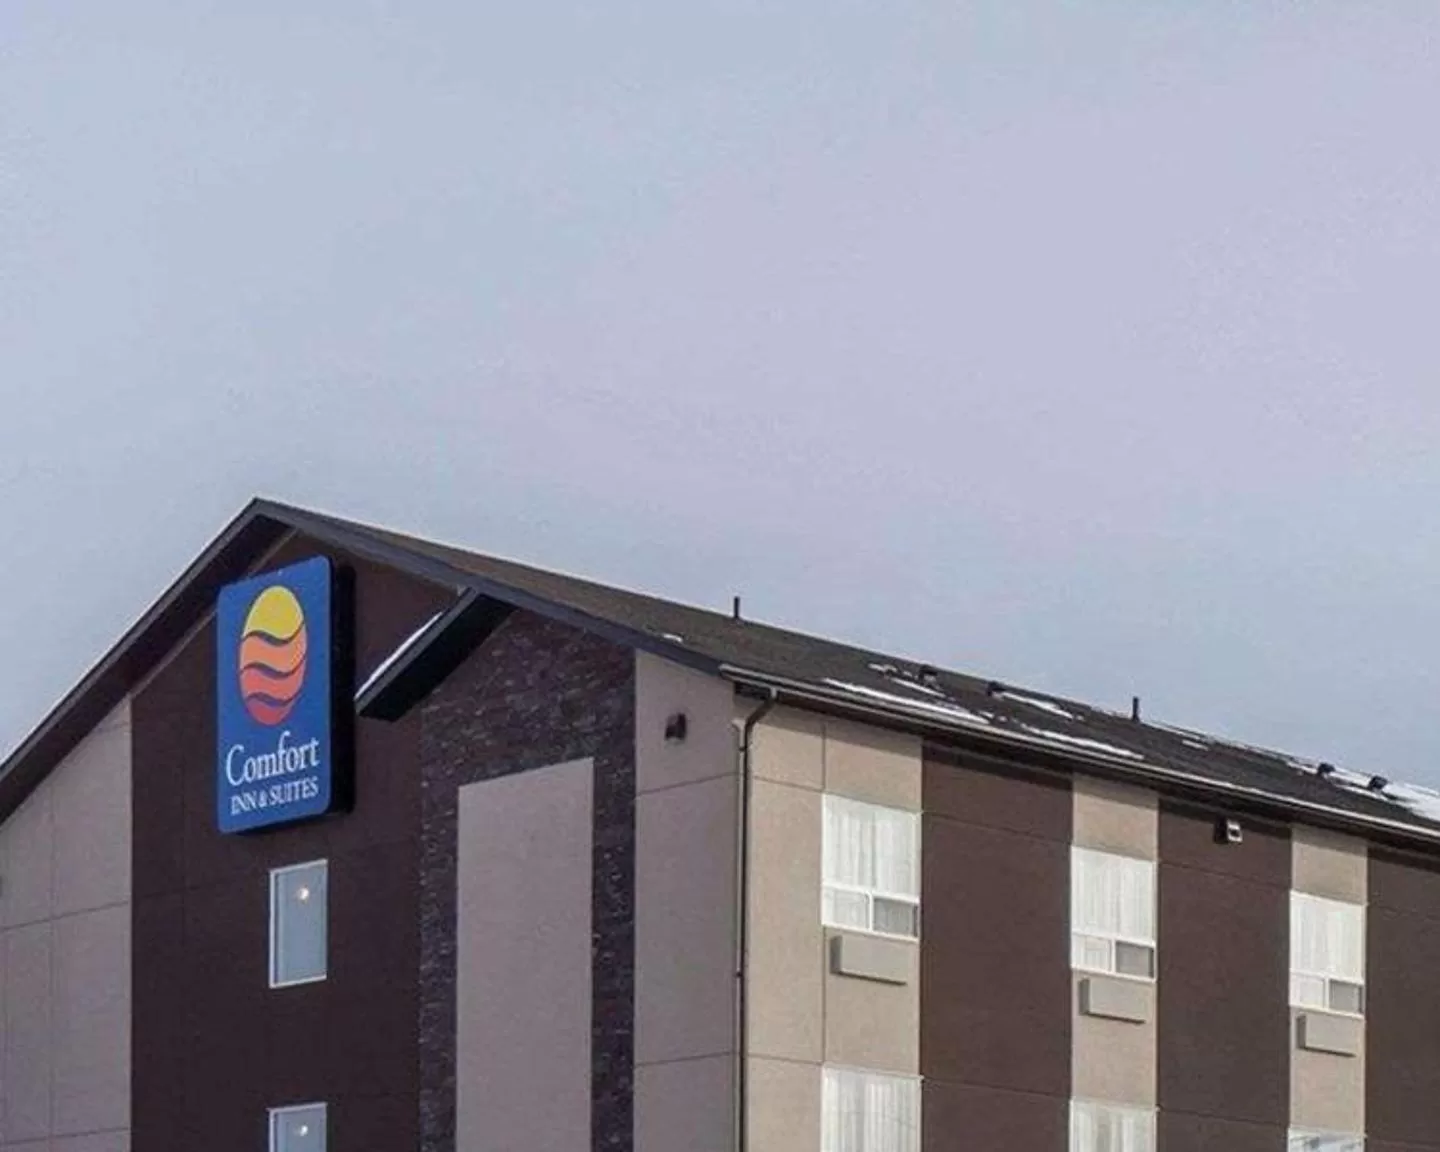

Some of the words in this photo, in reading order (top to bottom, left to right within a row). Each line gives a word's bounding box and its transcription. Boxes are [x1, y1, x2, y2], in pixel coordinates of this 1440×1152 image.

[226, 730, 320, 786] Comfort
[231, 790, 257, 816] INN
[269, 776, 319, 806] SUITES
